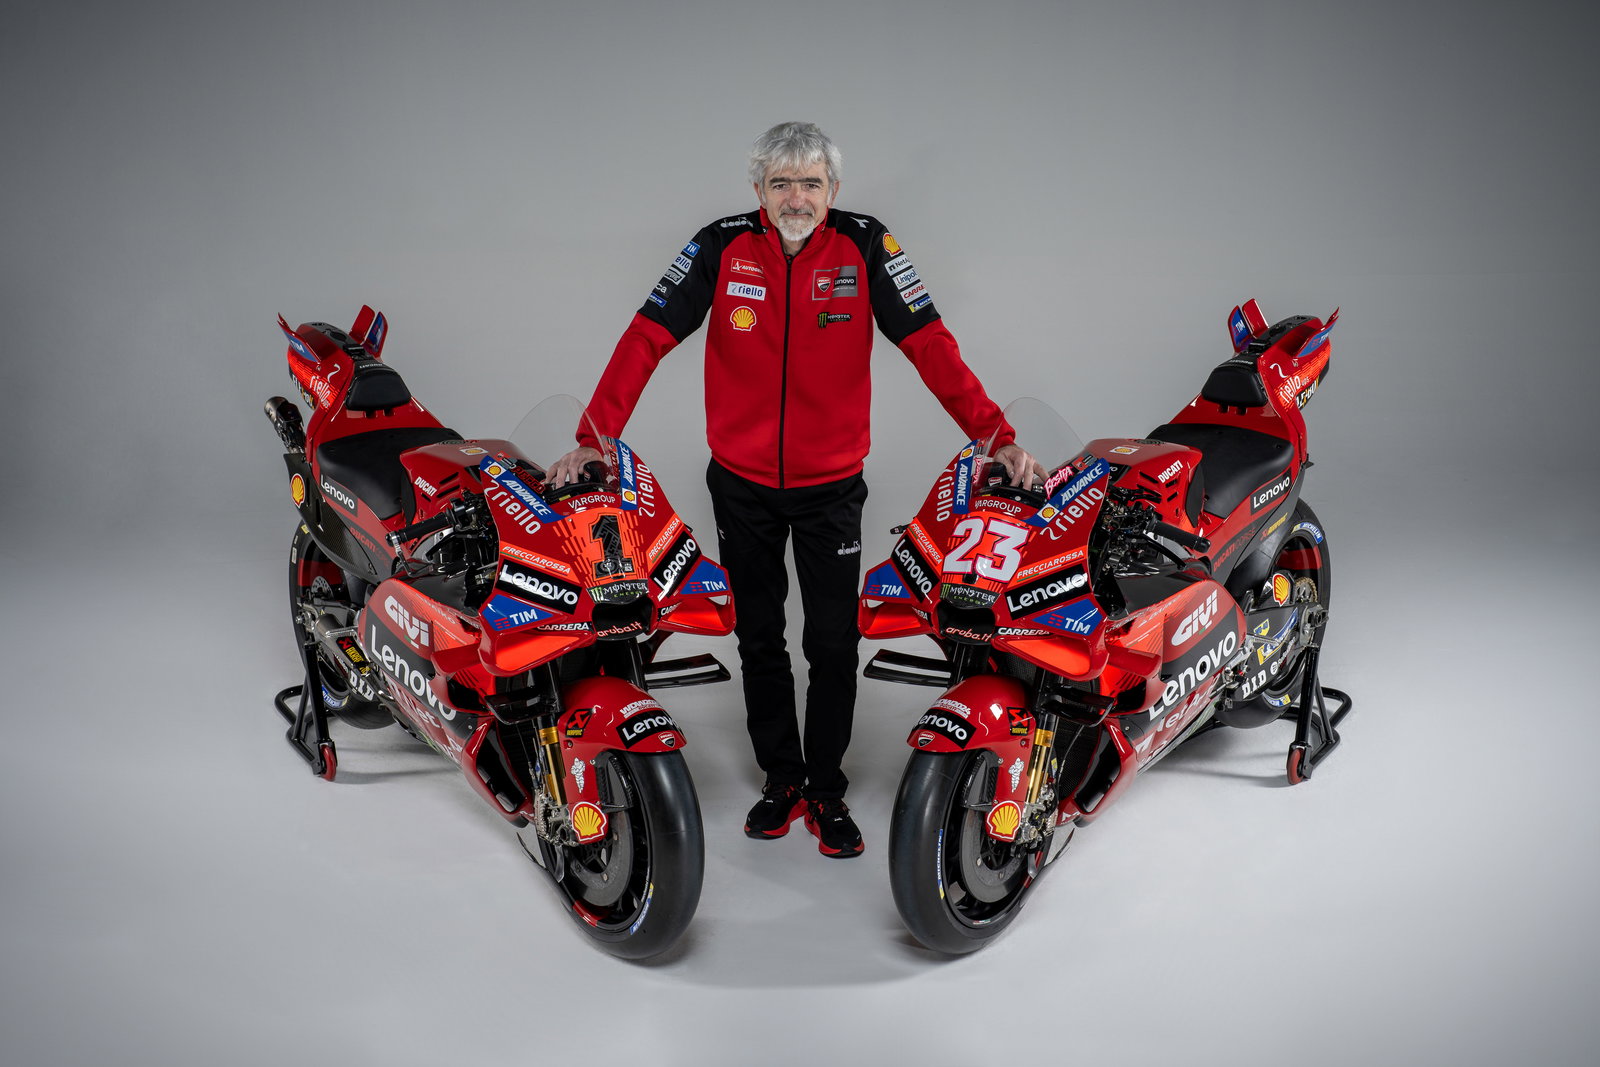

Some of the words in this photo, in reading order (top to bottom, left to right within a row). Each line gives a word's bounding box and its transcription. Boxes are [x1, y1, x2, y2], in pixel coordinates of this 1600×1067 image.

[738, 285, 763, 297] riello
[310, 375, 331, 403] riello
[1279, 375, 1301, 404] riello
[413, 475, 438, 498] DUCATI
[620, 443, 634, 487] ADVANCE
[637, 463, 656, 508] riello
[956, 463, 969, 506] ADVANCE
[1061, 463, 1104, 506] ADVANCE
[1157, 459, 1184, 484] DUCATI
[320, 473, 356, 511] Lenovo
[491, 491, 542, 536] riello
[501, 479, 552, 516] ADVANCE
[936, 474, 955, 523] riello
[1055, 487, 1105, 532] riello
[1252, 475, 1291, 510] Lenovo
[502, 545, 572, 574] FRECCIAROSSA
[588, 511, 637, 581] 1
[648, 516, 682, 562] FRECCIAROSSA
[910, 522, 943, 565] FRECCIAROSSA
[942, 515, 1032, 585] 23
[498, 563, 579, 606] Lenovo
[653, 538, 697, 602] Lenovo
[894, 538, 932, 596] Lenovo
[1016, 549, 1085, 579] FRECCIAROSSA
[701, 580, 727, 592] TIM
[880, 583, 903, 597] TIM
[1006, 572, 1088, 614] Lenovo
[384, 595, 430, 648] GIVI
[509, 608, 539, 626] TIM
[537, 621, 590, 632] CARRERA
[1064, 616, 1092, 636] TIM
[1170, 588, 1219, 648] GIVI
[371, 624, 457, 721] Lenovo
[1148, 630, 1233, 721] Lenovo
[1241, 669, 1268, 700] D.I.D
